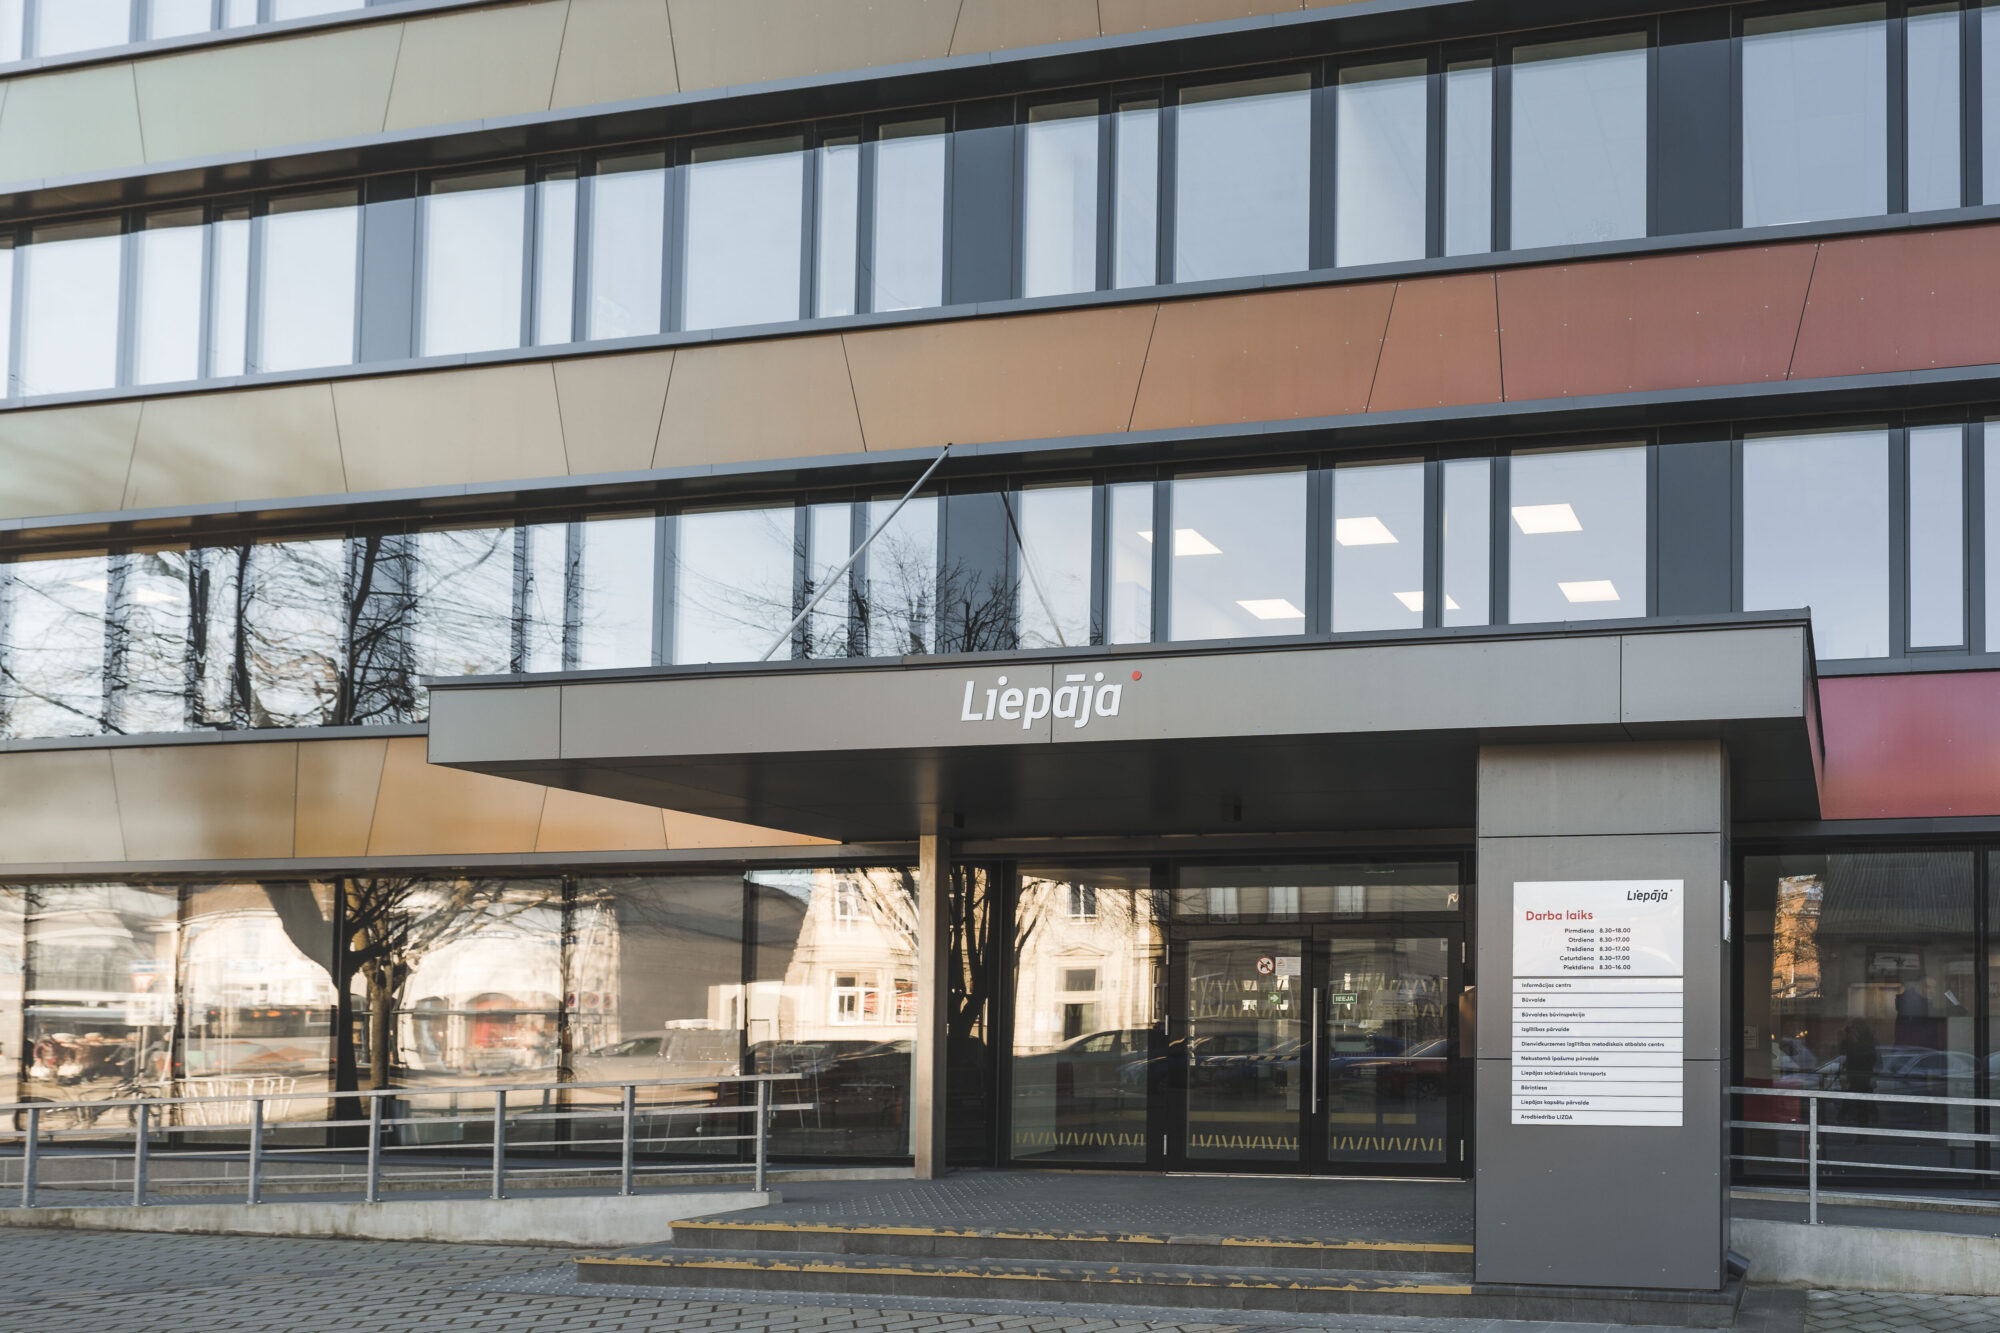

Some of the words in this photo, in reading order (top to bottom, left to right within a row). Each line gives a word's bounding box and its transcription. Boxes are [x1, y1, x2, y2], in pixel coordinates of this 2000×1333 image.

[960, 671, 1123, 730] Liepāja
[1626, 889, 1669, 903] Liepāja
[1525, 910, 1563, 921] Darba
[1565, 909, 1594, 921] laiks
[1565, 945, 1595, 953] Trešdiena
[1559, 954, 1595, 962] Ceturtdiena
[1562, 963, 1595, 971] Piektdiena
[1575, 1055, 1600, 1063] pārvalde
[1520, 1069, 1544, 1077] Liepājas
[1578, 1070, 1607, 1078] transports
[1565, 1099, 1590, 1107] pārvalde
